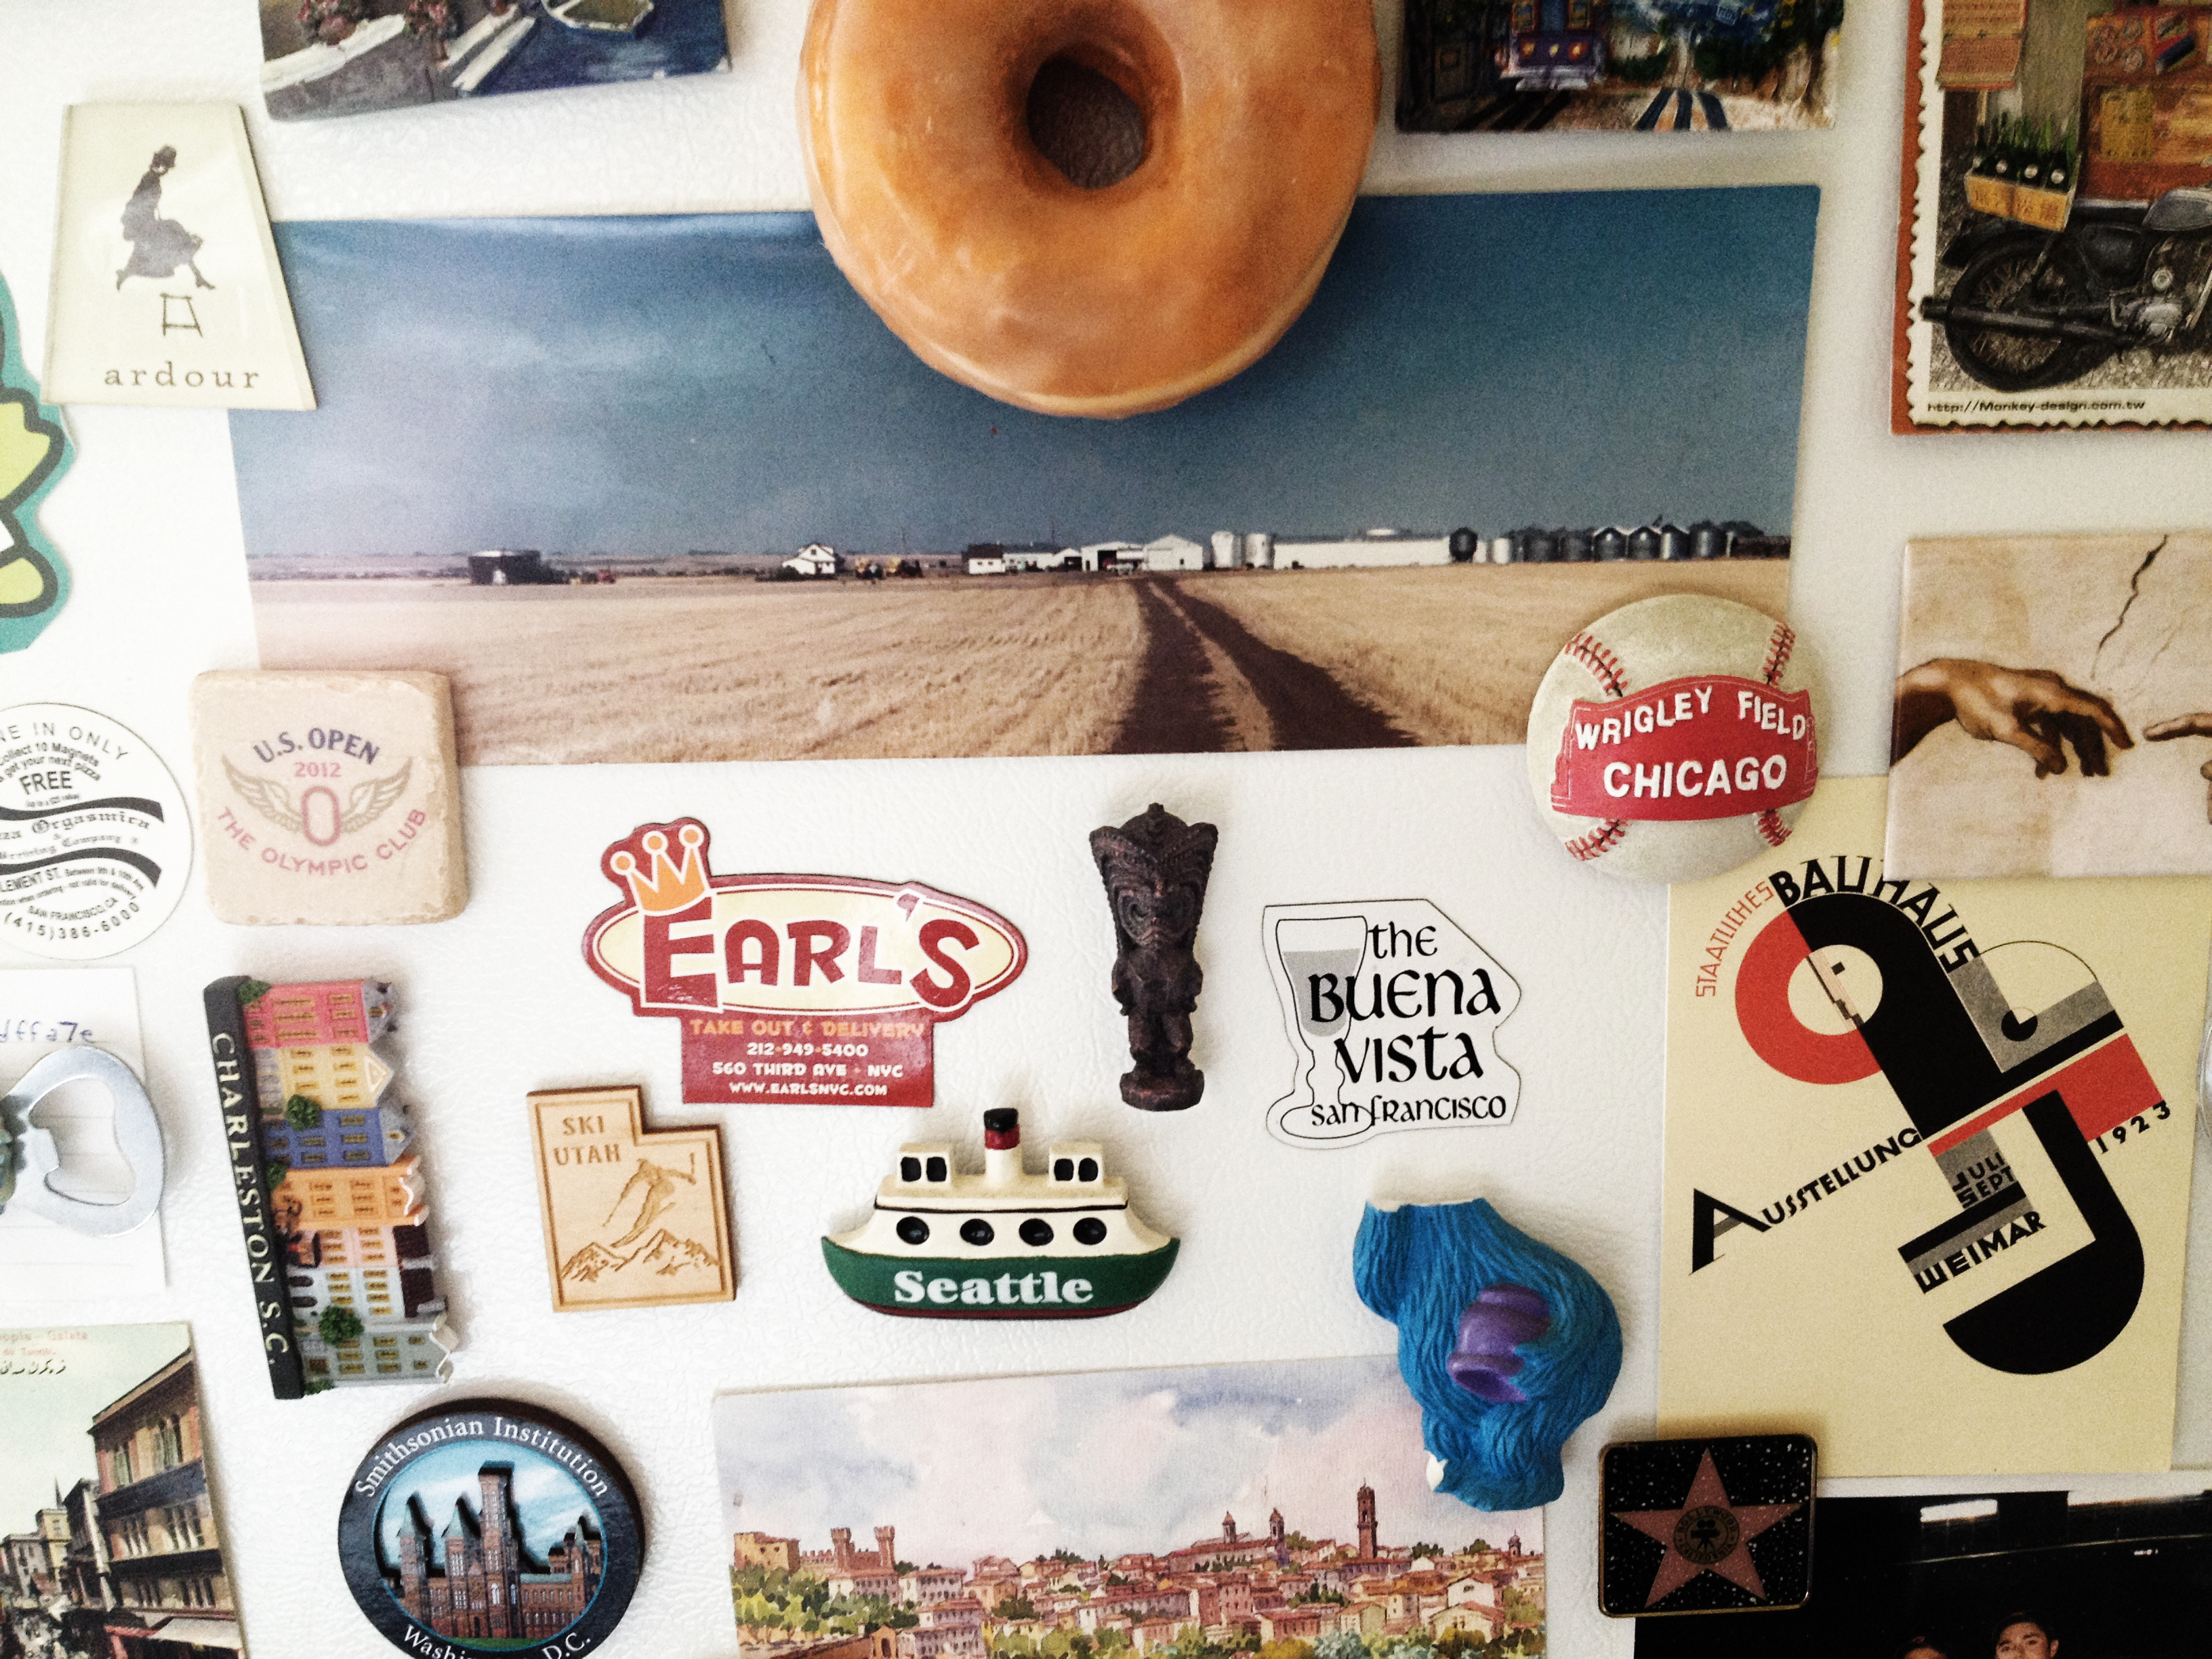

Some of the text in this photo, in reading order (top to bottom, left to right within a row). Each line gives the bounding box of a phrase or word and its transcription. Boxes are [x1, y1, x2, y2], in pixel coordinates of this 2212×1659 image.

[104, 361, 260, 388] ardour
[1575, 685, 1806, 751] WRIGLEY FIELD
[33, 722, 54, 736] IN
[69, 726, 127, 760] ONLY
[253, 728, 380, 764] U.S. OPEN
[19, 771, 73, 795] FREE
[295, 762, 341, 777] 2012
[1603, 754, 1788, 799] CHICAGO
[218, 806, 426, 876] THE OLYMPIC CLUB
[1368, 921, 1437, 959] the
[1696, 855, 1981, 998] STAATLICHES BAUHAUS
[642, 893, 980, 1008] EARL'S
[689, 1019, 743, 1036] TAKE
[751, 1020, 794, 1036] OUT
[821, 1021, 926, 1039] DELIVERY
[712, 1062, 904, 1078] 560 THIRD AVE NYC
[729, 1082, 888, 1096] WWW.EARLSNYC.COM
[562, 1116, 606, 1136] SKI
[2094, 1100, 2171, 1154] 1923
[211, 1031, 275, 1285] CHARLESTON
[553, 1143, 622, 1166] UTAH
[1952, 1151, 2006, 1191] JULI
[1688, 1127, 1923, 1276] AUSSTELLUNG
[1958, 1166, 2016, 1210] SEPT
[1914, 1210, 2047, 1294] WEIMAR
[894, 1270, 1094, 1305] Seattle
[354, 1416, 609, 1498] Smithsonian Institution
